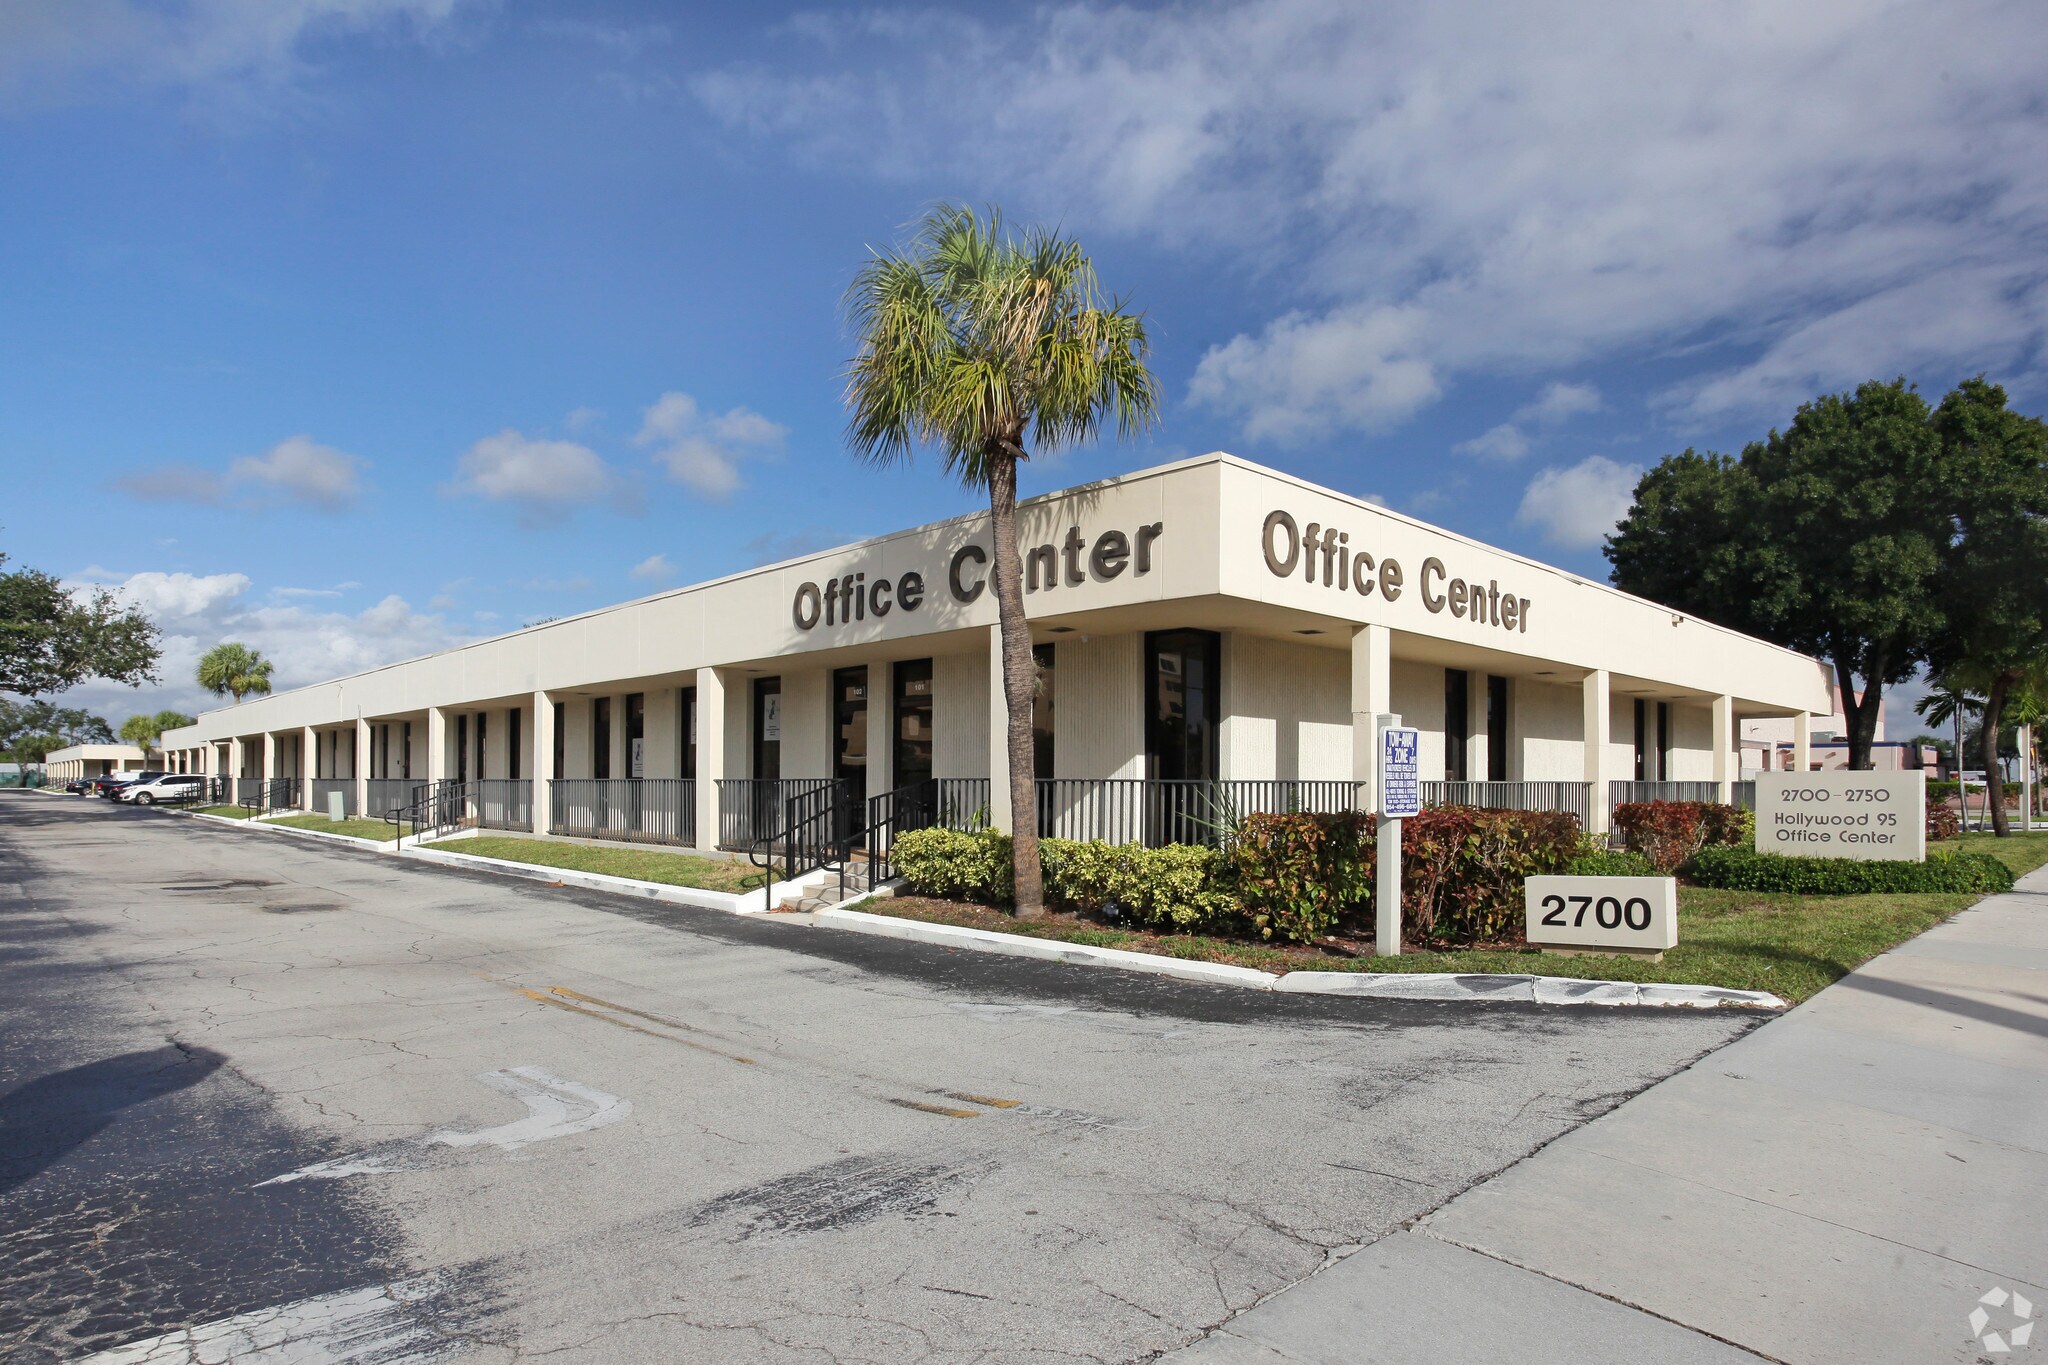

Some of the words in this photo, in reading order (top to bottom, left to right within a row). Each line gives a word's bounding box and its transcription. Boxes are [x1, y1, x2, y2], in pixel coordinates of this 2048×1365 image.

[795, 571, 925, 630] Office
[949, 521, 1163, 603] Cnter
[1262, 510, 1403, 602] Office
[1420, 557, 1530, 633] Center
[914, 683, 925, 691] 101
[1389, 732, 1414, 747] TOW-AWAY
[1394, 748, 1409, 764] ZONE
[1781, 788, 1830, 802] 2700
[1845, 788, 1890, 802] 2750
[1774, 812, 1869, 828] Hollywood
[1876, 812, 1897, 826] 95
[1775, 829, 1831, 842] Office
[1838, 830, 1896, 844] Center
[1541, 894, 1652, 931] 2700
